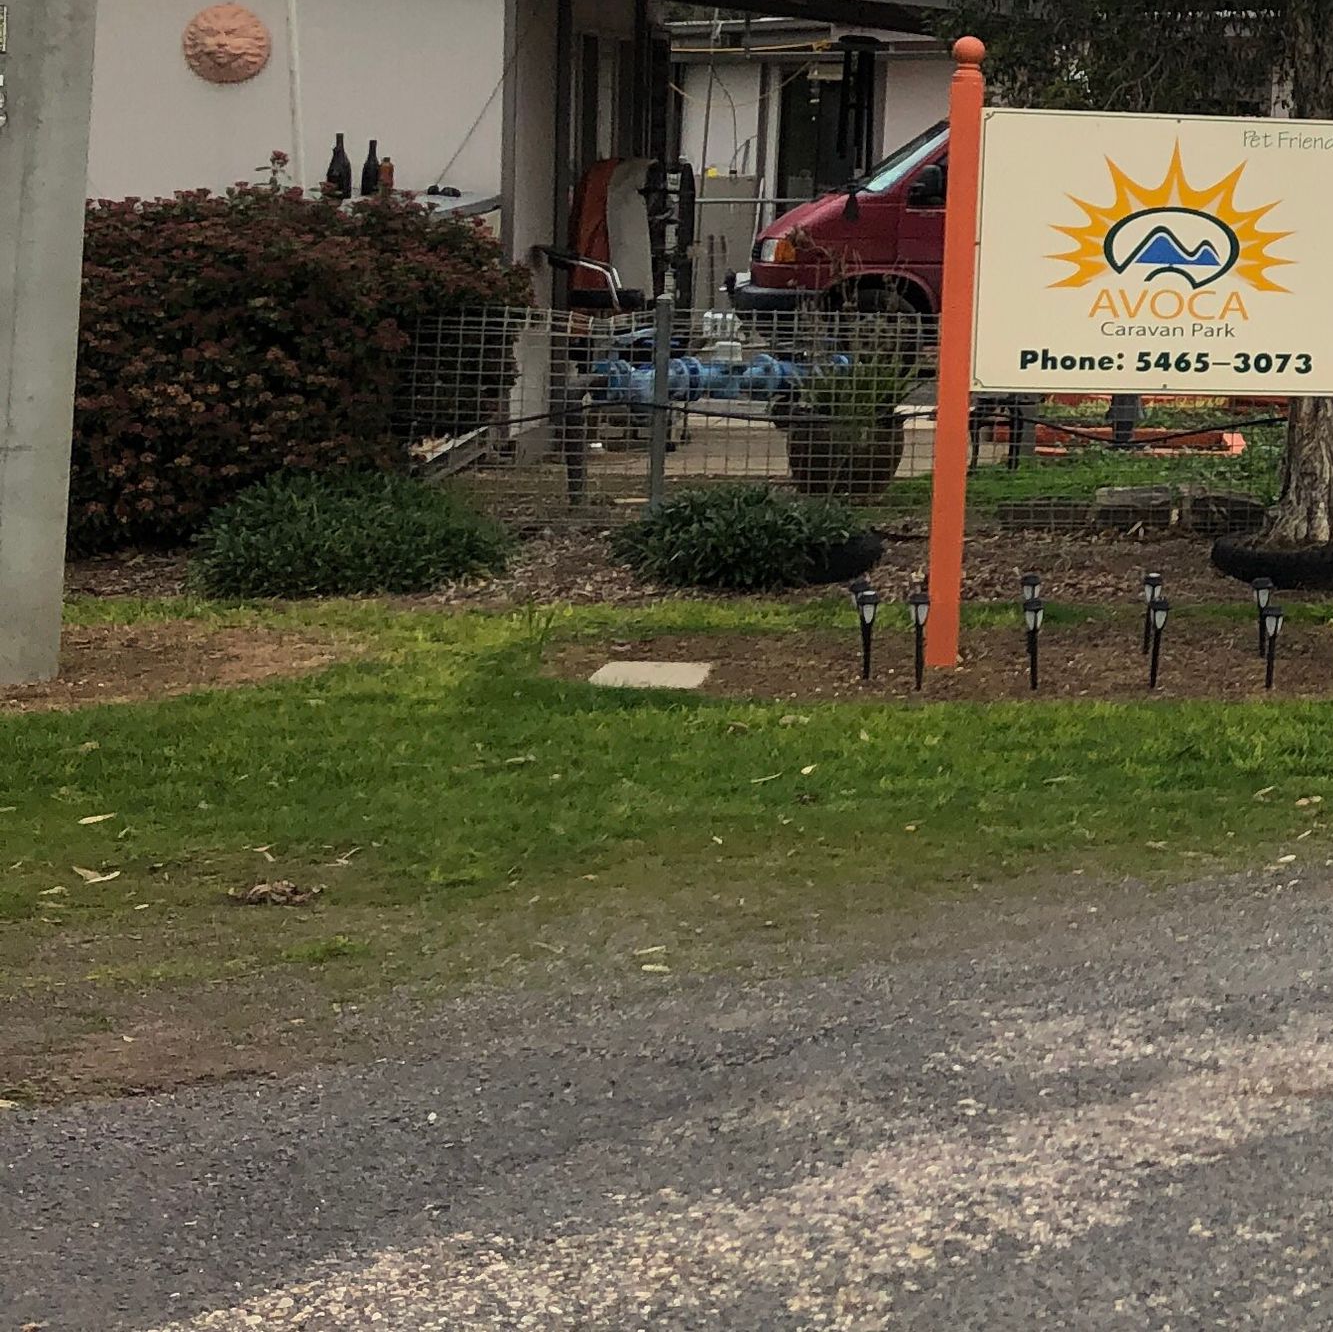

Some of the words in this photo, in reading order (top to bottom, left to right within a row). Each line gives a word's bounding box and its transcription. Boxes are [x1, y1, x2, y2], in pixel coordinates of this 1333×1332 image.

[1243, 130, 1272, 148] Pet
[1088, 289, 1249, 320] AVOCA
[1100, 321, 1184, 337] Caravan
[1191, 323, 1236, 338] Park
[1019, 350, 1126, 371] Phone:
